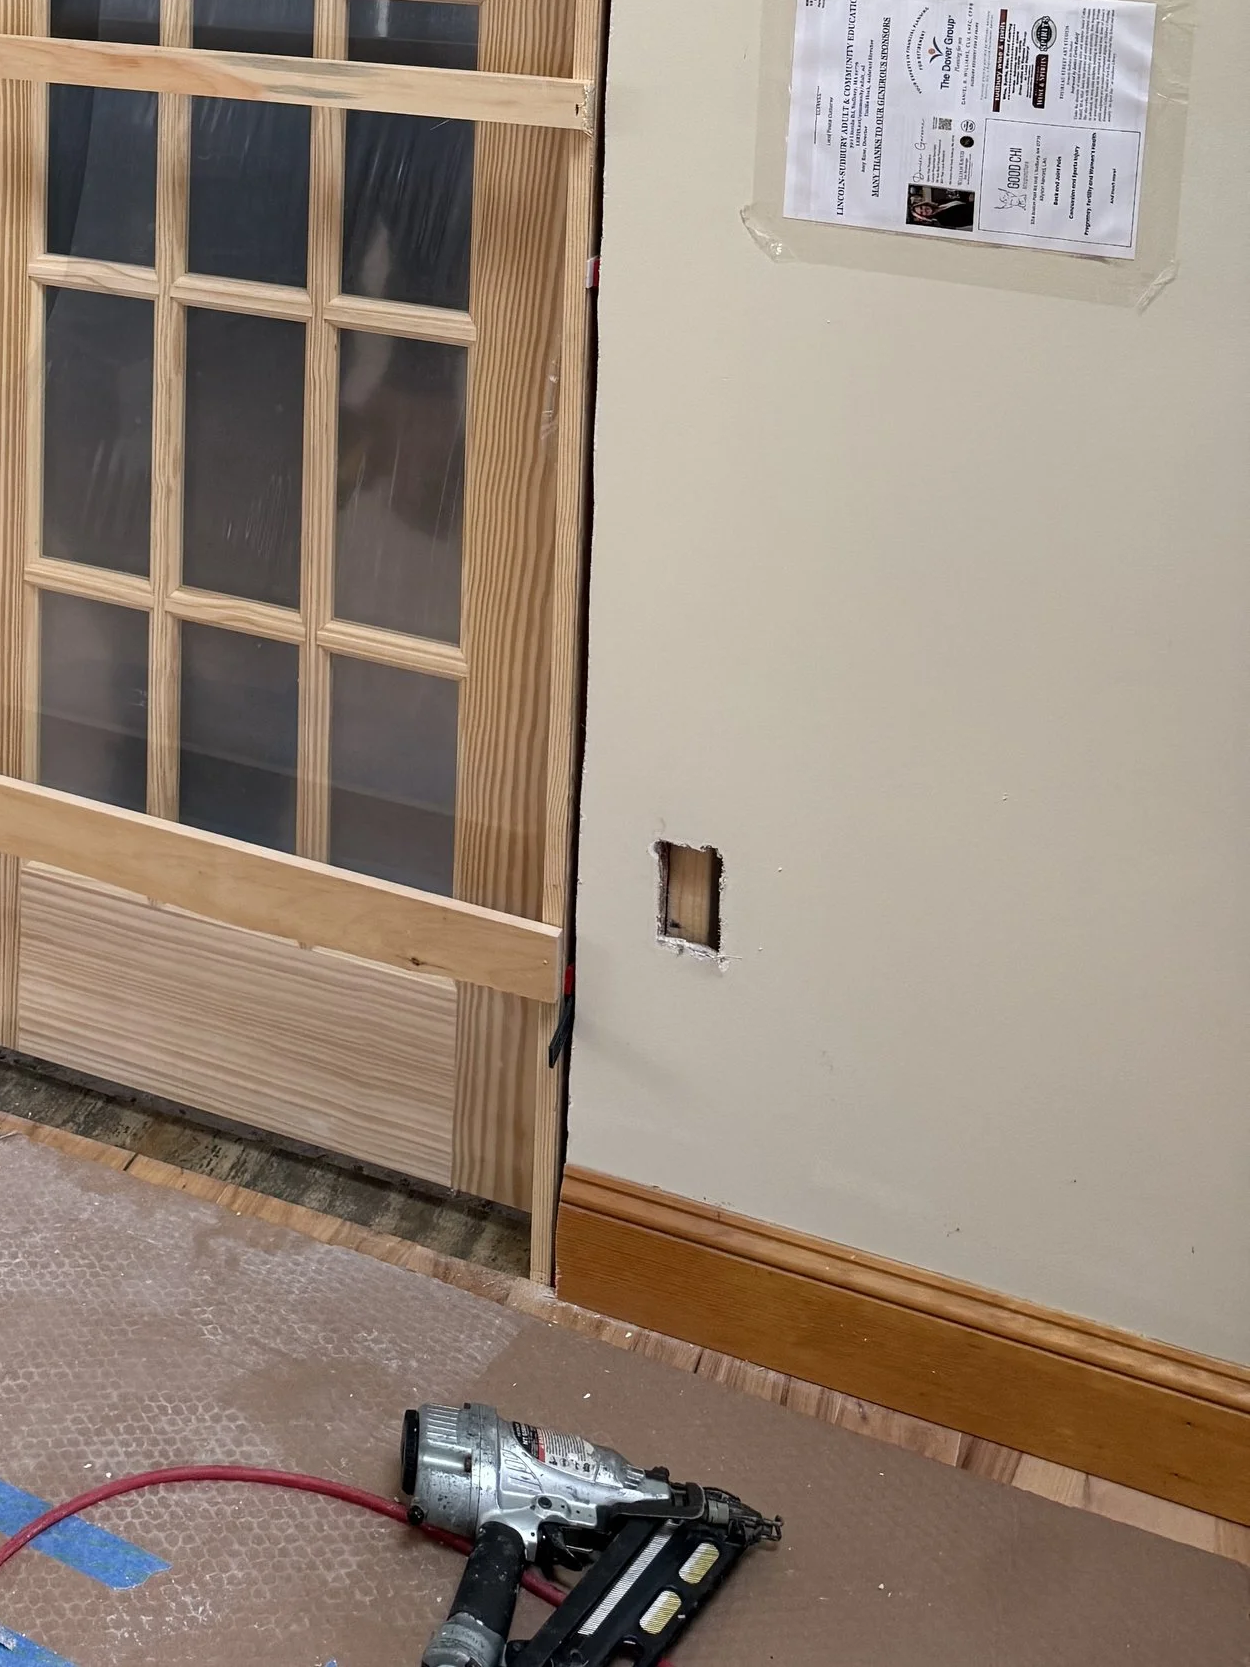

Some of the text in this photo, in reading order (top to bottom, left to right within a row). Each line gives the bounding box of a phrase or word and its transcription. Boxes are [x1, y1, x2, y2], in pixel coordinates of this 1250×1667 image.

[1039, 15, 1049, 51] SPIRITS
[942, 46, 952, 72] Dover
[940, 74, 950, 89] The
[871, 17, 891, 197] MANY THANKS TO OUR GENEROUS SPONSORS
[836, 136, 847, 215] LINCOLN-SUDBURY
[844, 43, 853, 96] COMMUNITY
[1007, 148, 1022, 189] GOOD CHI
